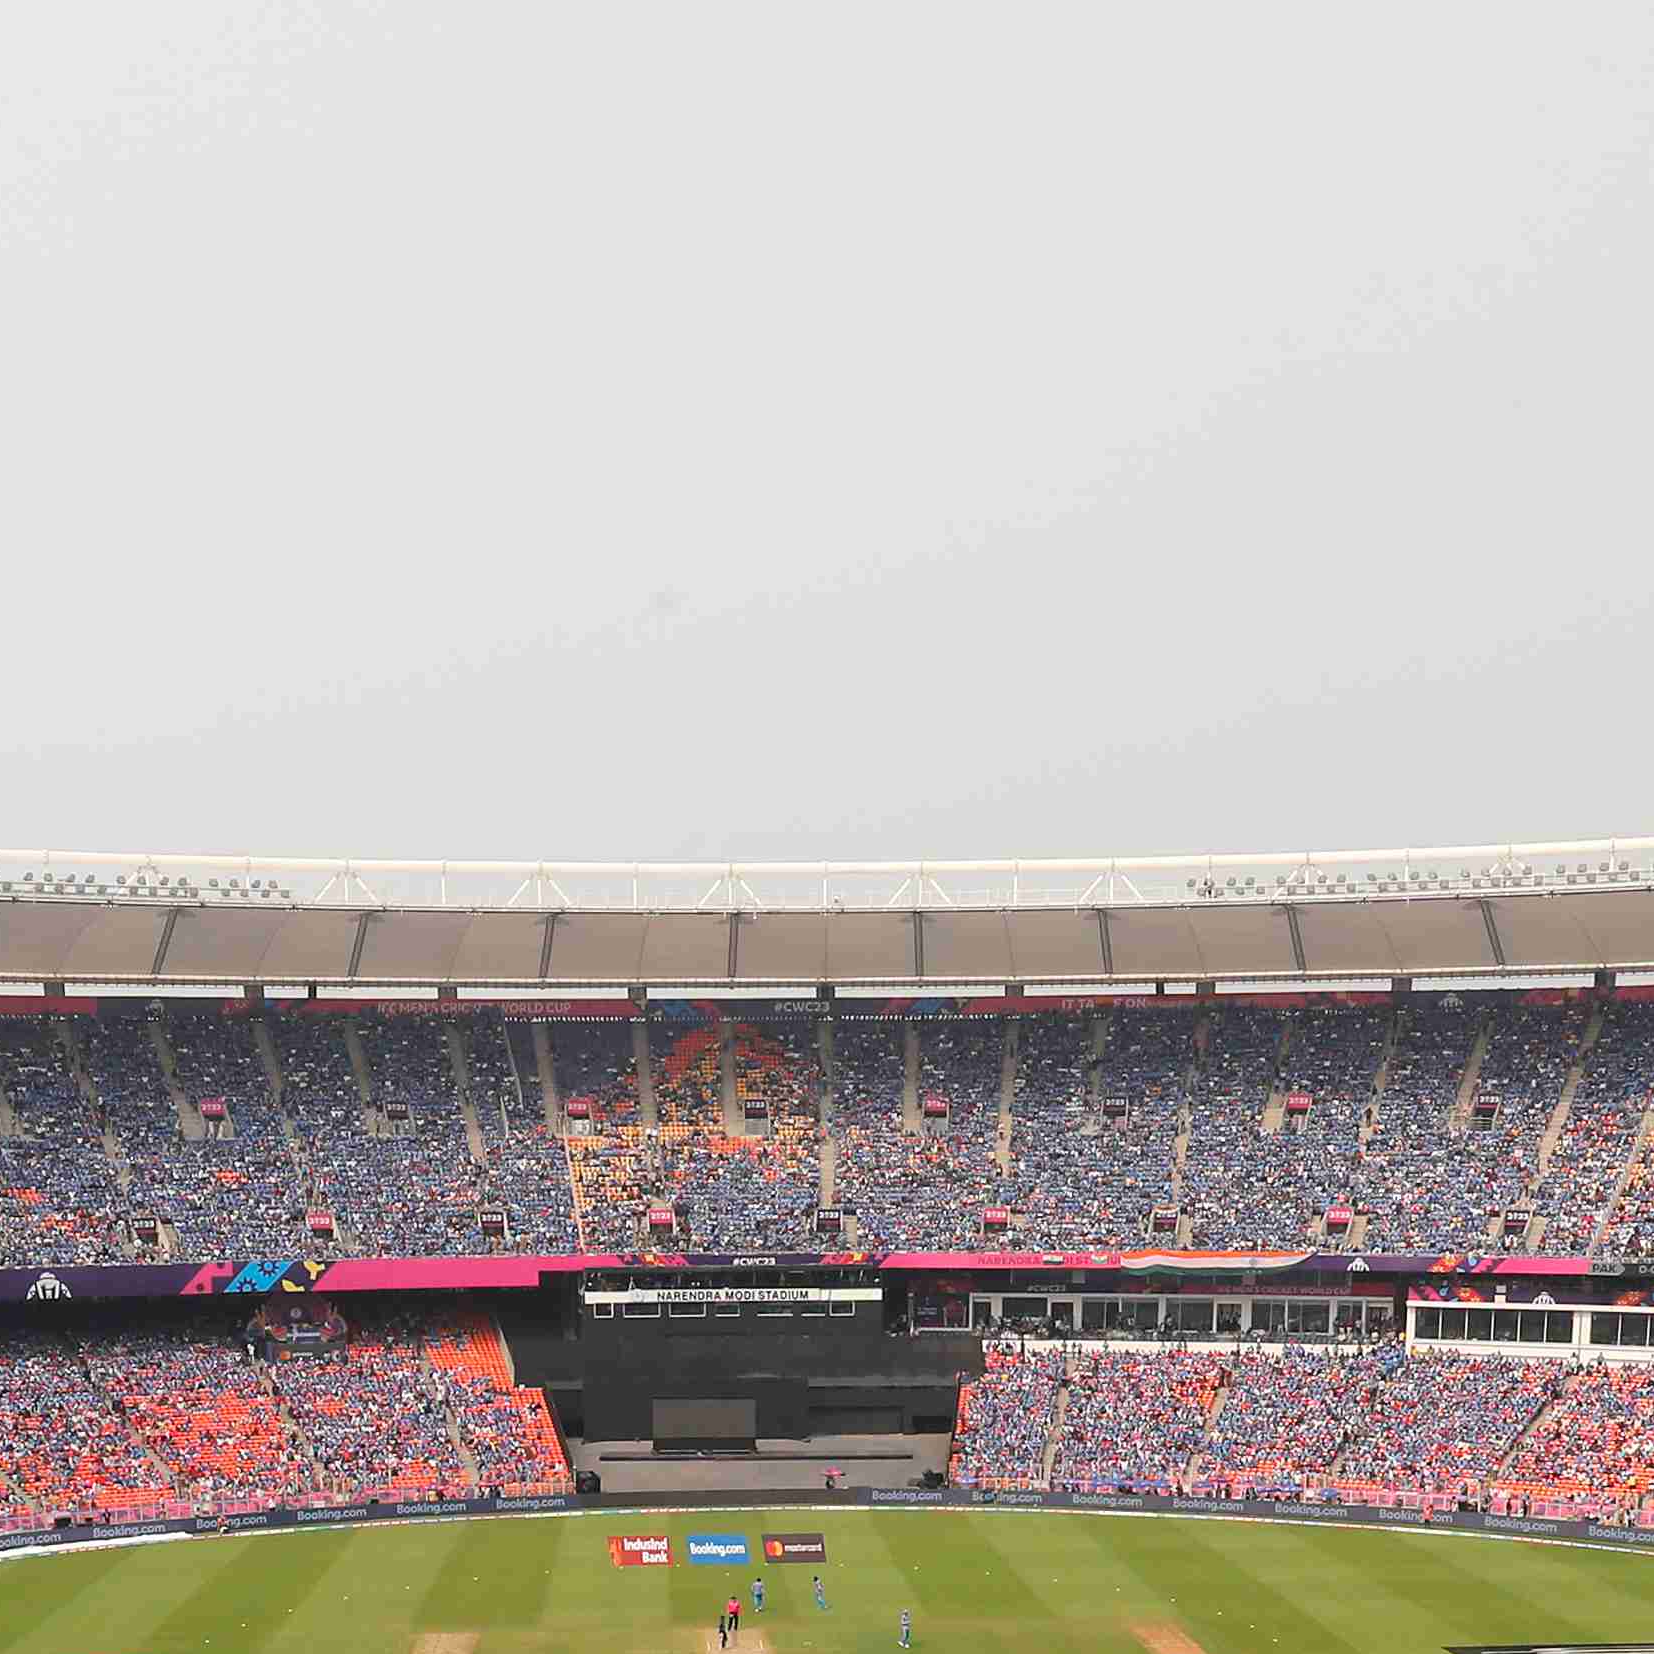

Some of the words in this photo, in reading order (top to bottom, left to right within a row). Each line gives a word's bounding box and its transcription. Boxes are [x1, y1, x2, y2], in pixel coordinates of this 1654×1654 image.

[1591, 1264, 1618, 1275] PAK
[656, 1289, 721, 1301] NARENDRA
[724, 1289, 756, 1301] MODI
[756, 1289, 809, 1301] STADIUM
[872, 1490, 943, 1503] Booking.com
[1073, 1494, 1143, 1508] Booking.com
[397, 1502, 466, 1514] Booking.com
[496, 1497, 565, 1511] Booking.com
[1173, 1499, 1244, 1513] Booking.com
[1275, 1503, 1347, 1517] Booking.com
[297, 1508, 367, 1522] Booking.com
[93, 1524, 166, 1538] Booking.com
[1485, 1517, 1558, 1534] Booking.com
[622, 1536, 668, 1551] IndusInd
[689, 1541, 746, 1557] Booking.com
[641, 1550, 669, 1564] Bank
